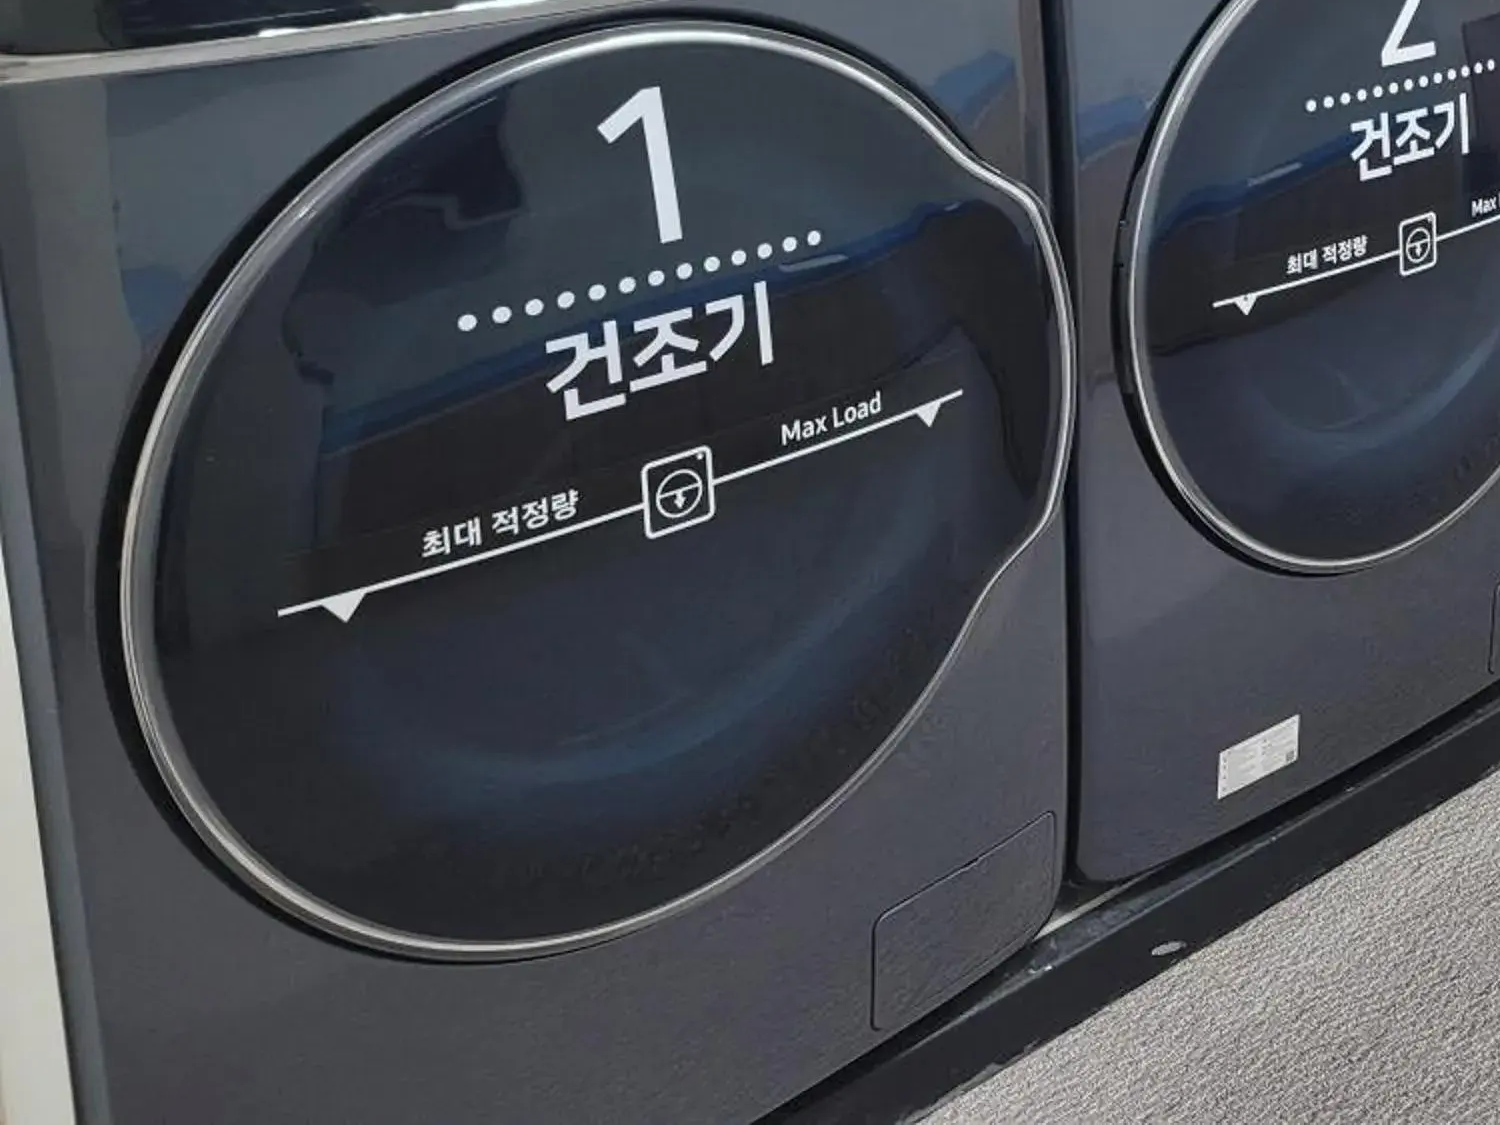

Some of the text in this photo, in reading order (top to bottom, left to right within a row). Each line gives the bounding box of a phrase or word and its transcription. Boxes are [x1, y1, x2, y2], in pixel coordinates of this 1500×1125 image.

[597, 87, 682, 243] 1
[1350, 93, 1469, 182] 건조기
[1471, 199, 1497, 217] Max
[1286, 235, 1368, 275] 최대 적정량
[545, 280, 773, 421] 건조기
[781, 392, 882, 446] Max Load
[421, 489, 580, 559] 최대 적정량
